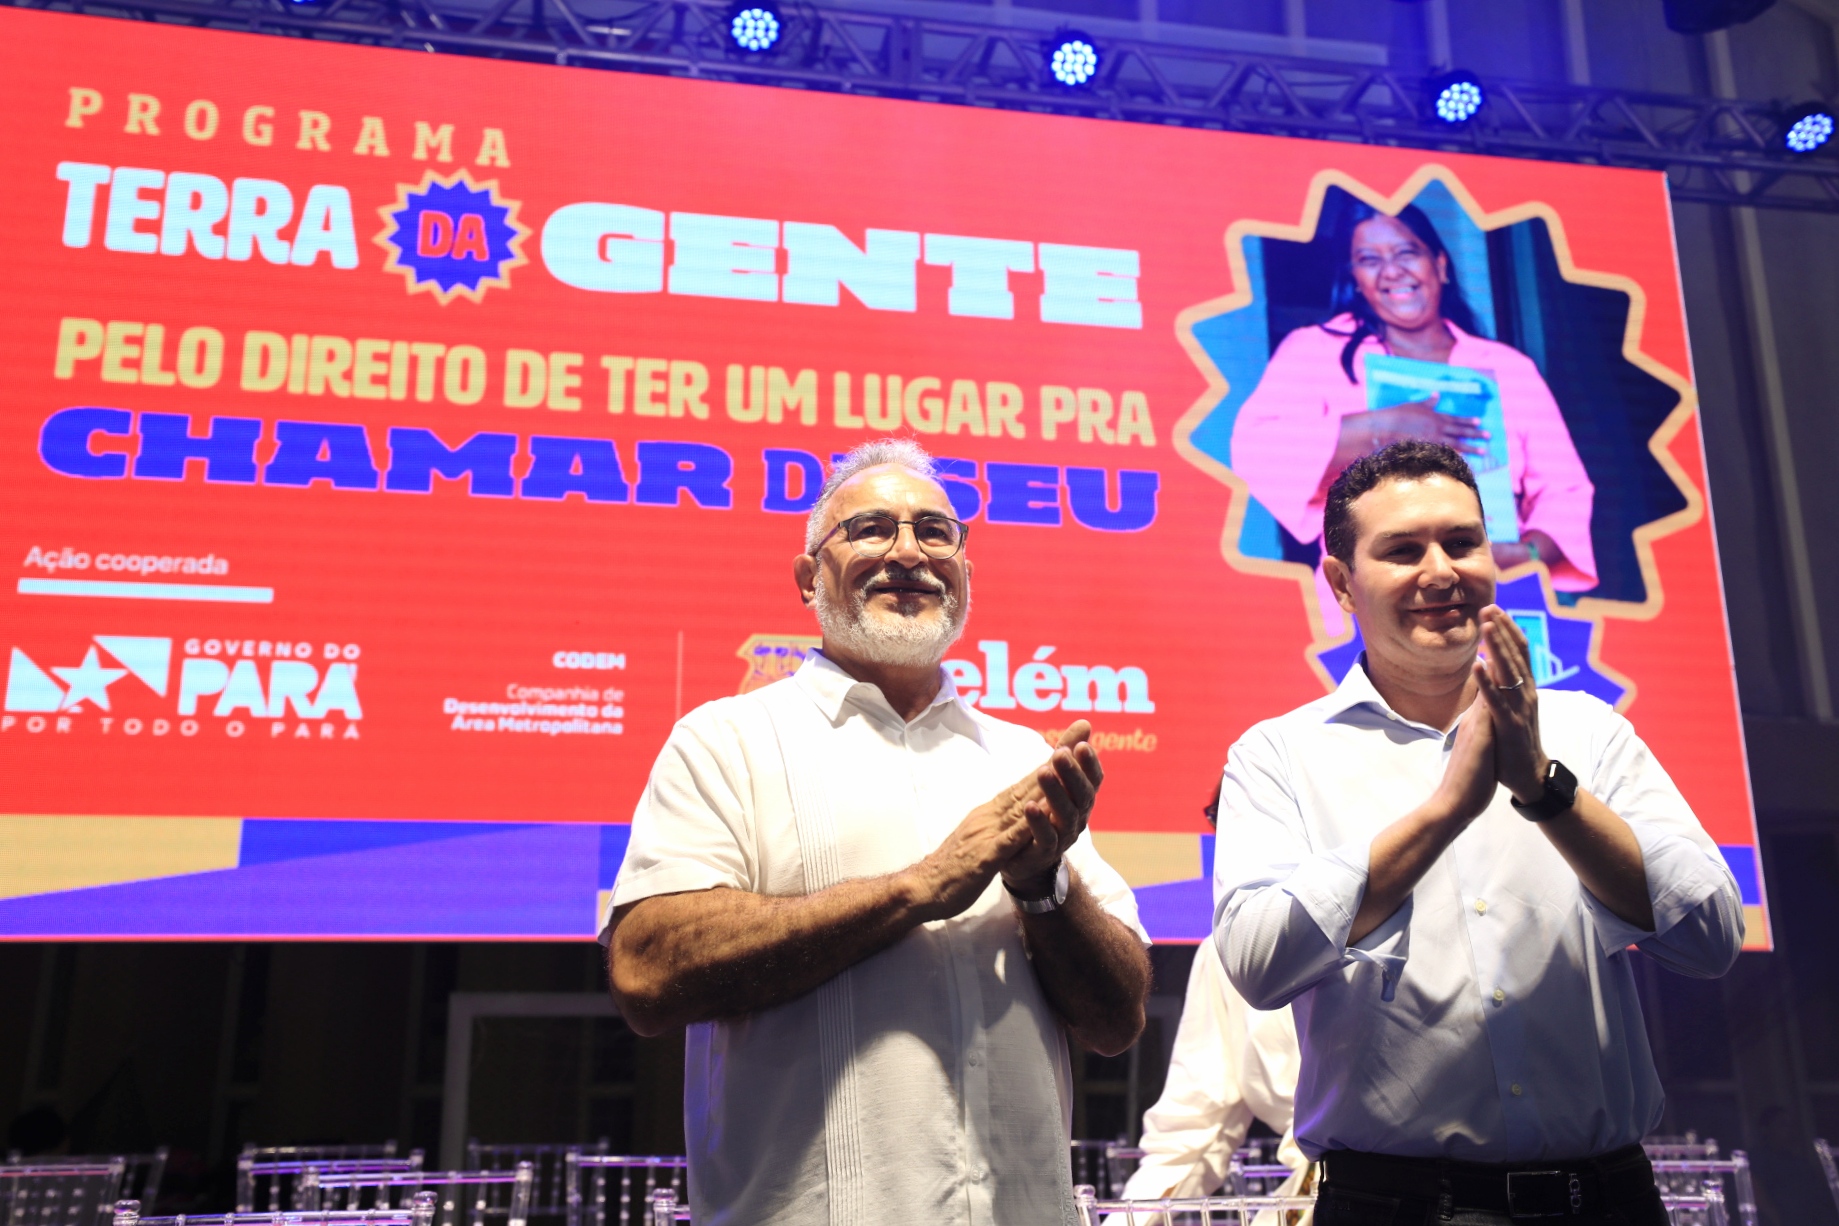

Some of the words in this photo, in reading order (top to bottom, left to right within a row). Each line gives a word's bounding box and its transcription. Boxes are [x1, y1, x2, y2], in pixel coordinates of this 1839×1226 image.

[64, 86, 511, 168] PROGRAMA
[56, 160, 360, 270] TERRA
[416, 209, 490, 262] DA
[540, 202, 1144, 330] GENTE
[53, 316, 225, 389] PELO
[240, 330, 487, 405] DIREITO
[503, 348, 584, 412] DE
[600, 354, 710, 420] TER
[725, 363, 818, 426] UM
[833, 370, 1026, 440] LUGAR
[1040, 384, 1157, 447] PRA
[39, 406, 733, 509] CHAMAR
[762, 447, 848, 514] D
[24, 545, 91, 574] Ação
[94, 553, 229, 576] cooperada
[183, 637, 313, 659] GOVERNO
[323, 642, 361, 660] DO
[552, 650, 626, 671] CODEM
[940, 639, 1156, 714] elém
[506, 683, 600, 703] Companhia
[602, 687, 625, 702] de
[443, 697, 598, 719] Desenvolvimento
[600, 702, 624, 719] da
[0, 715, 72, 734] POR
[100, 716, 200, 738] TODO
[225, 720, 247, 738] O
[498, 716, 624, 737] Metropolitana
